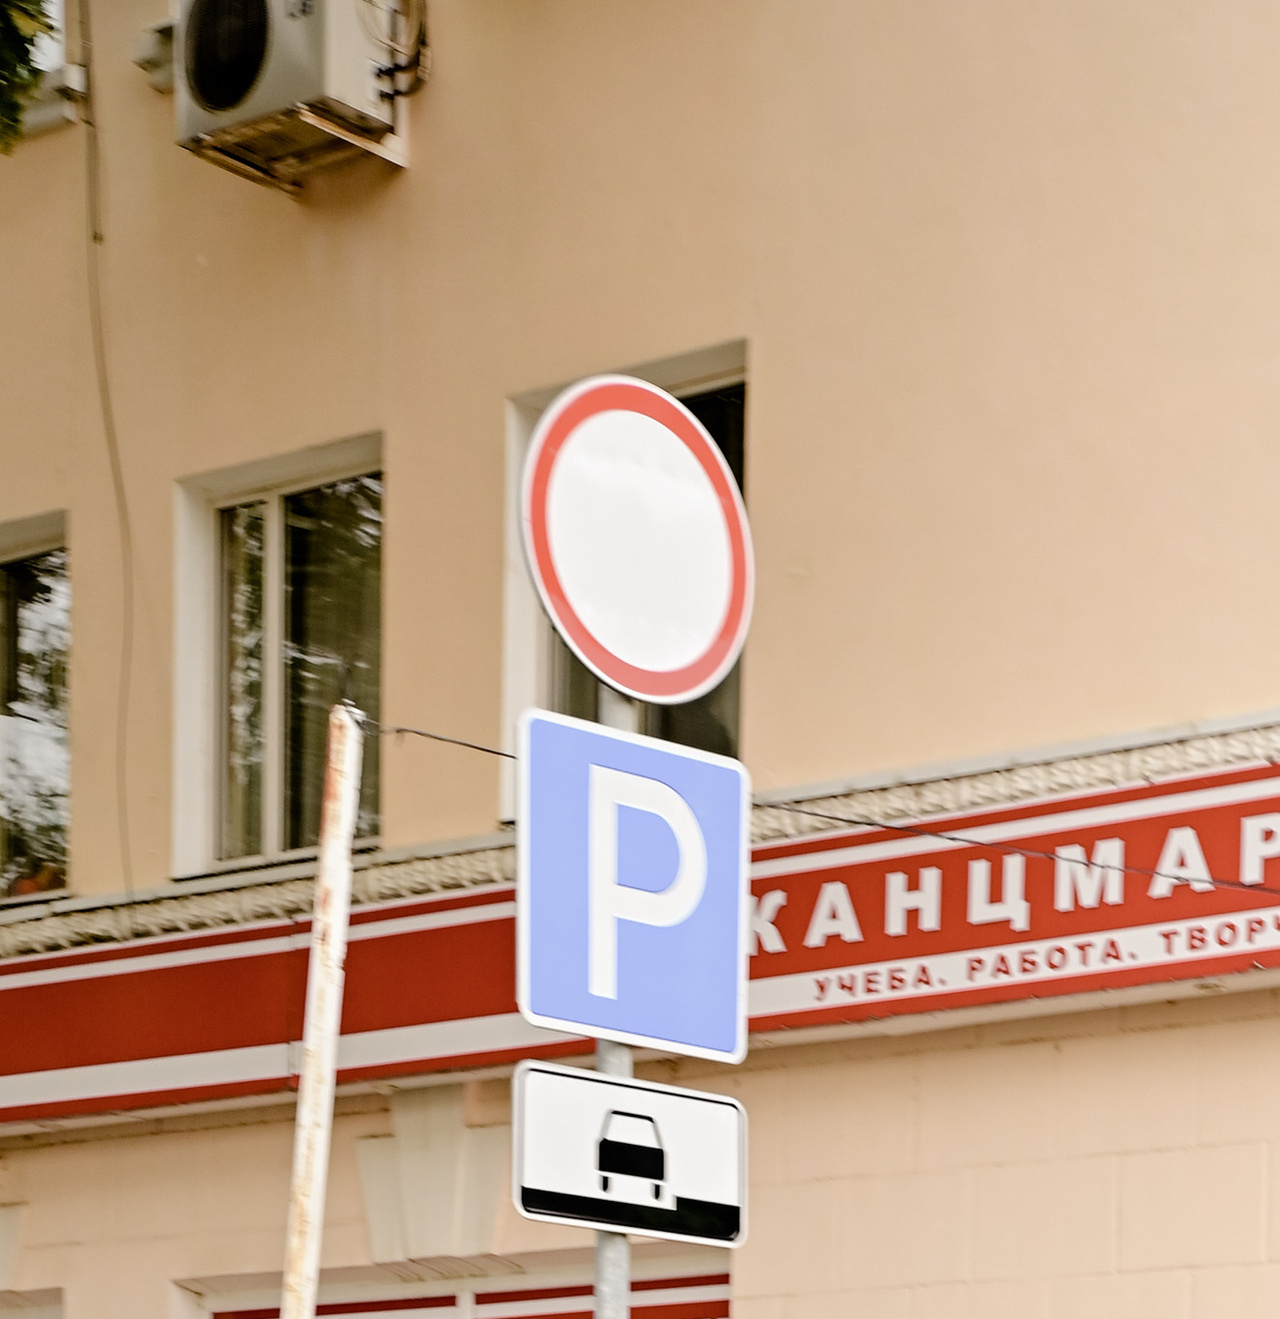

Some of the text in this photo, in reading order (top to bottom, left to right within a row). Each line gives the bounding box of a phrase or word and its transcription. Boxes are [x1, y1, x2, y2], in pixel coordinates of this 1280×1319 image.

[587, 762, 708, 1001] P
[812, 963, 948, 1001] УЧЕБА.
[965, 938, 1138, 981] РАБОТА.
